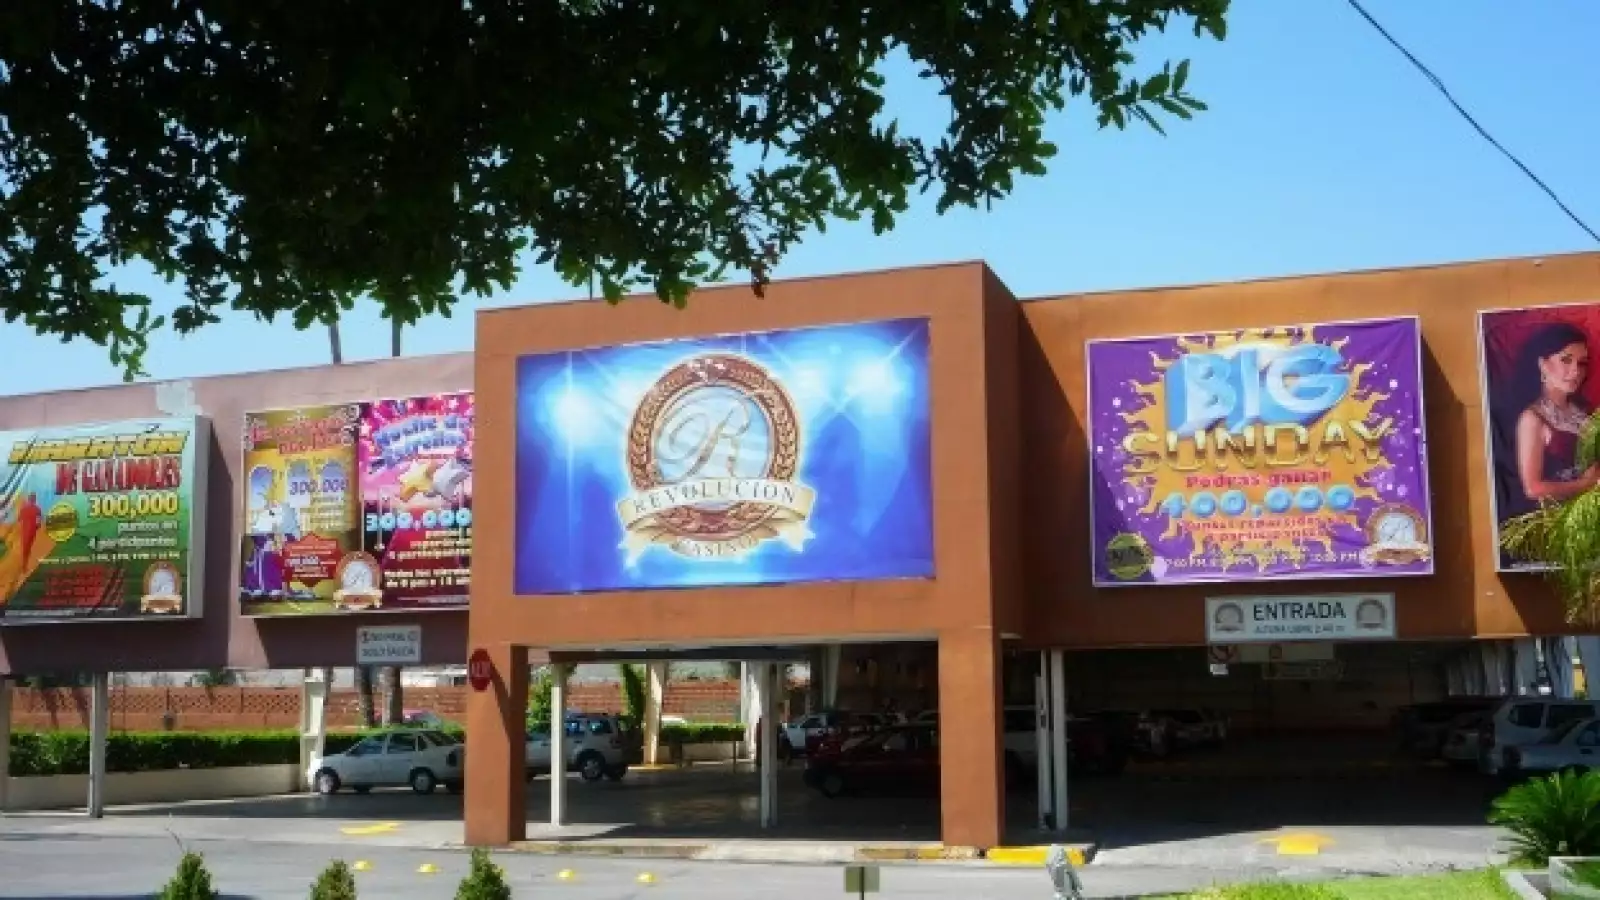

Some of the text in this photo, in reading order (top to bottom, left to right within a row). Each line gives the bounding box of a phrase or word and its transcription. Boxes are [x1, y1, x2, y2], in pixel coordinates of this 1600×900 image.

[1165, 343, 1352, 435] BIG
[1122, 418, 1395, 474] SUNDAY
[1267, 470, 1332, 488] ganar
[89, 492, 178, 519] 300,000
[1253, 602, 1346, 621] ENTRADA
